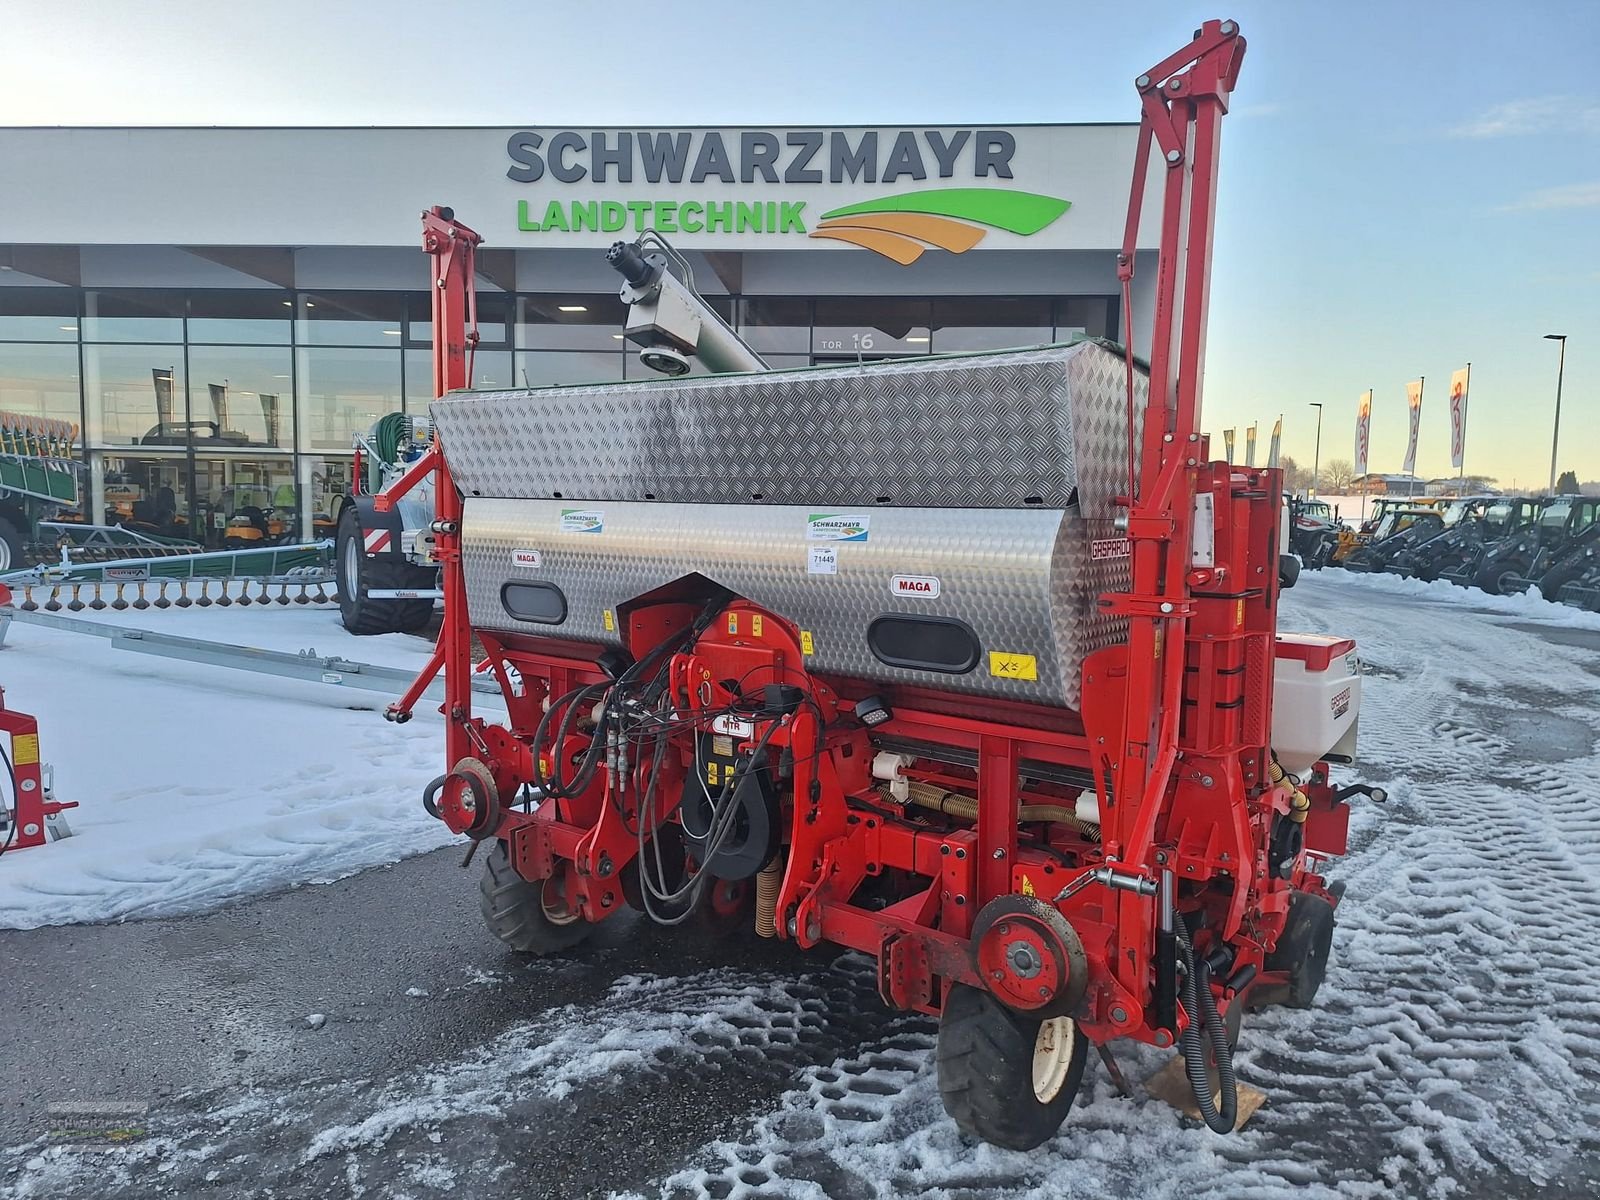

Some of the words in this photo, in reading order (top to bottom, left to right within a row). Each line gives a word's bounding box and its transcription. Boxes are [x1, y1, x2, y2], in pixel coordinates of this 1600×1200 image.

[506, 131, 1016, 184] SCHWARZMAYR
[517, 200, 807, 233] LANDTECHNIK
[821, 340, 842, 349] TOR
[852, 333, 874, 350] 16
[516, 554, 536, 562] MAGA
[814, 555, 835, 563] 71449
[899, 580, 931, 592] MAGA
[722, 720, 741, 731] MTR
